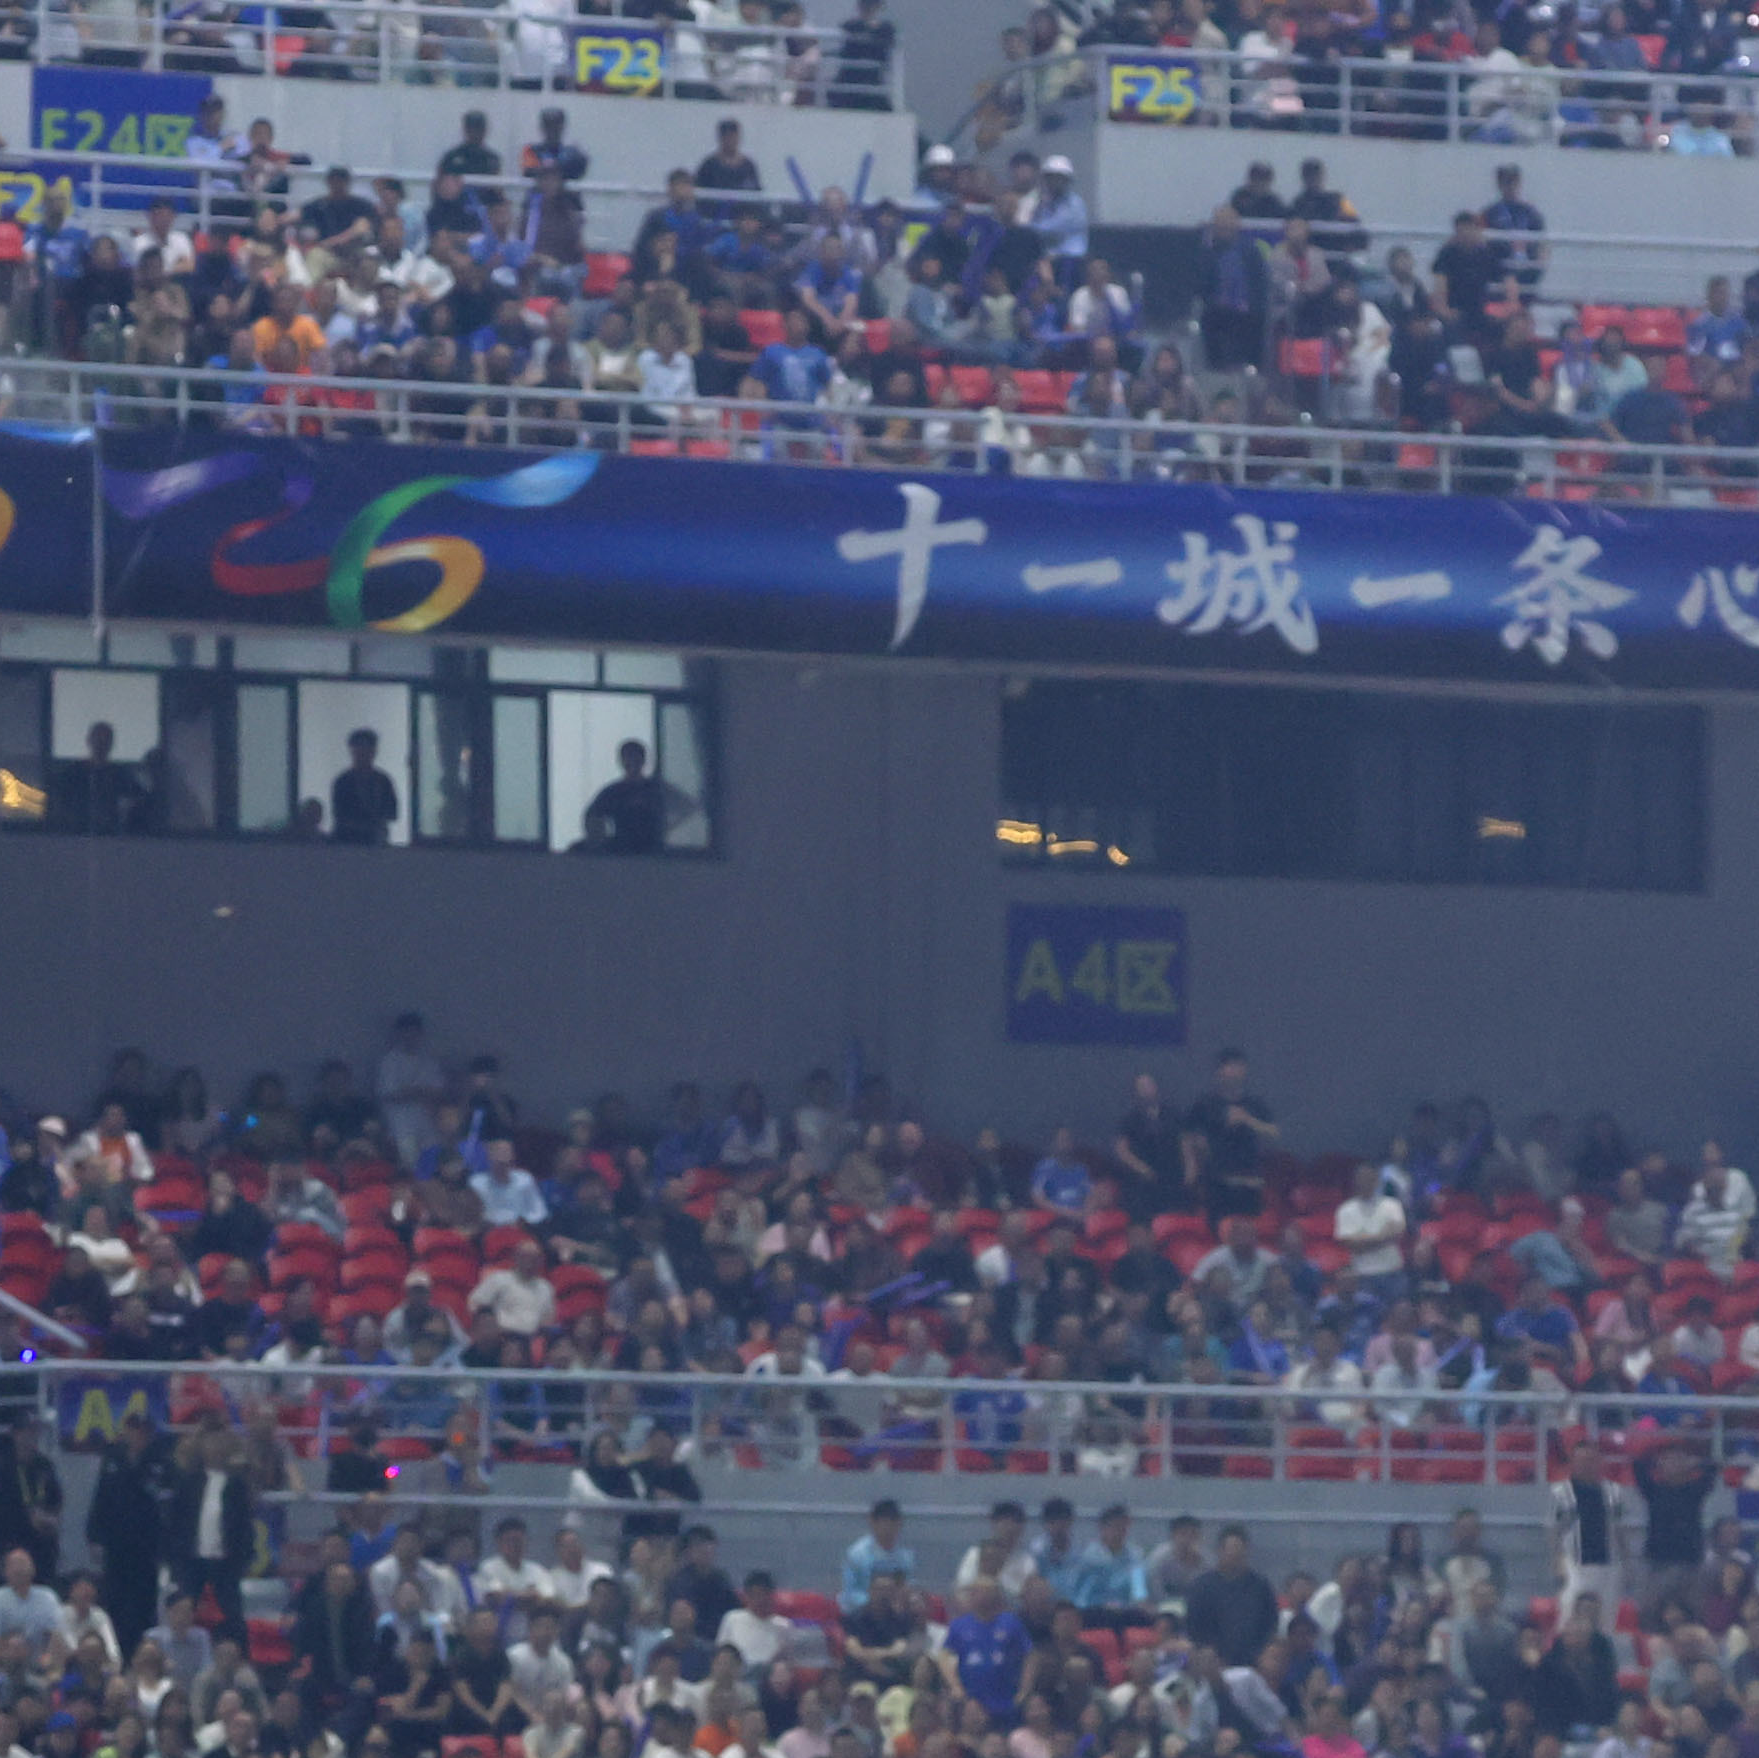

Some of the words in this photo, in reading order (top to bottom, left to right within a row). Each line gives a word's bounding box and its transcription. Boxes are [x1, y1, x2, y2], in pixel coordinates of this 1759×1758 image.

[576, 36, 660, 90] F23
[1110, 65, 1195, 119] F25
[1017, 938, 1179, 1013] A4区
